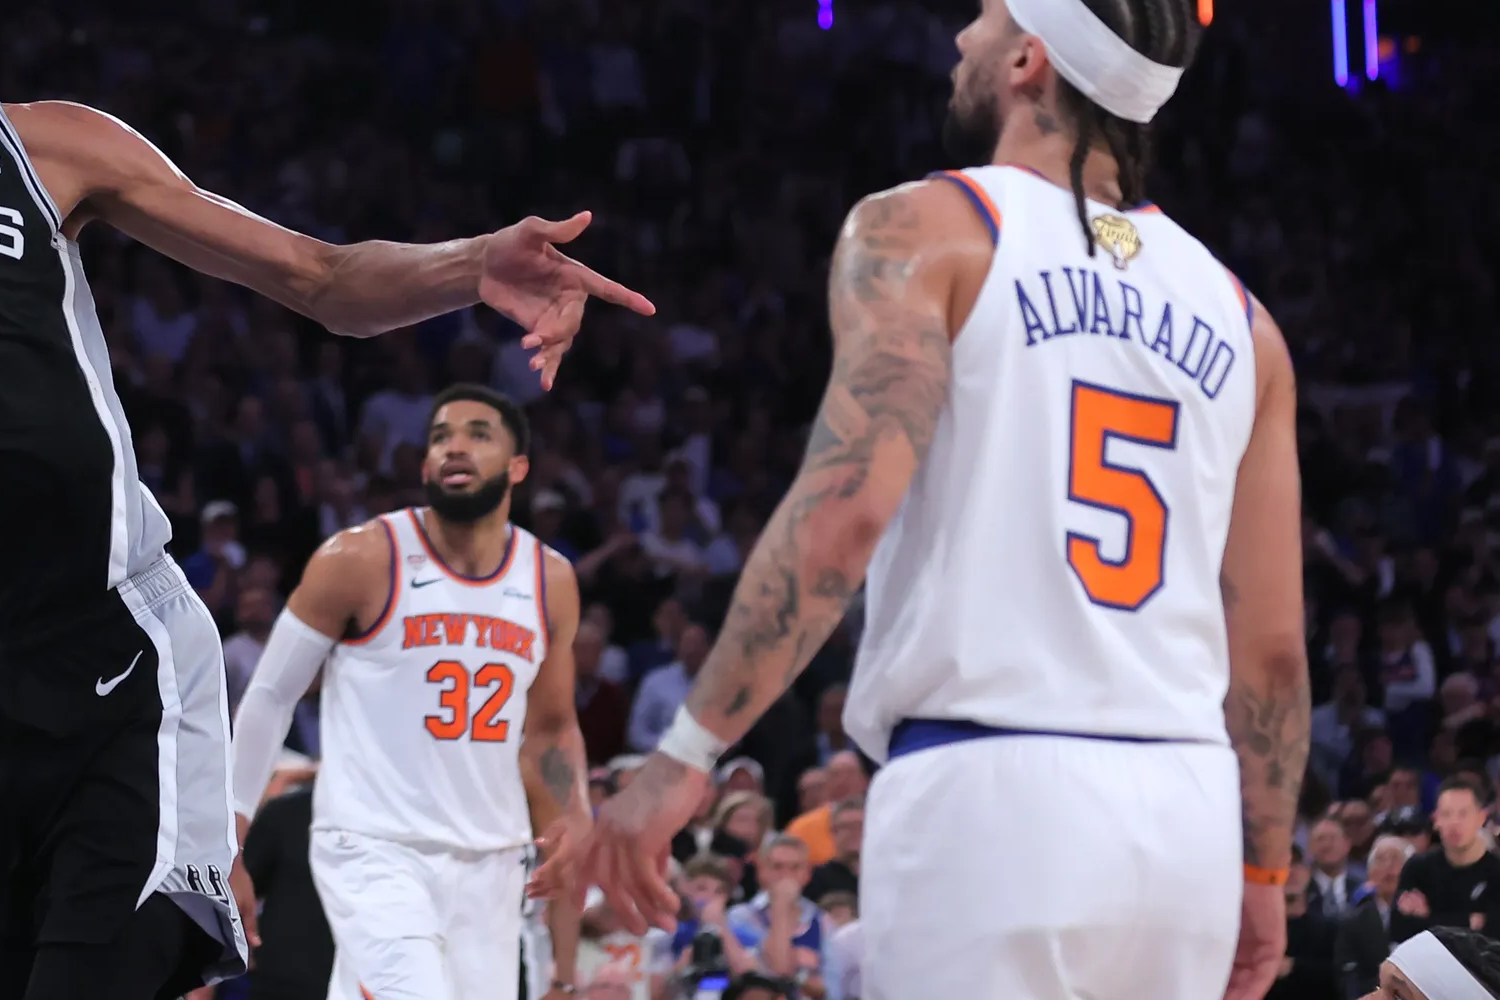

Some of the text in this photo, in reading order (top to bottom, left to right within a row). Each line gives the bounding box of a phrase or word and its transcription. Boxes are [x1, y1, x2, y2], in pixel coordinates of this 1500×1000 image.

[1014, 267, 1236, 400] ALVARADO
[1066, 379, 1181, 613] 5
[402, 612, 536, 664] NEW YORK
[424, 660, 515, 742] 32
